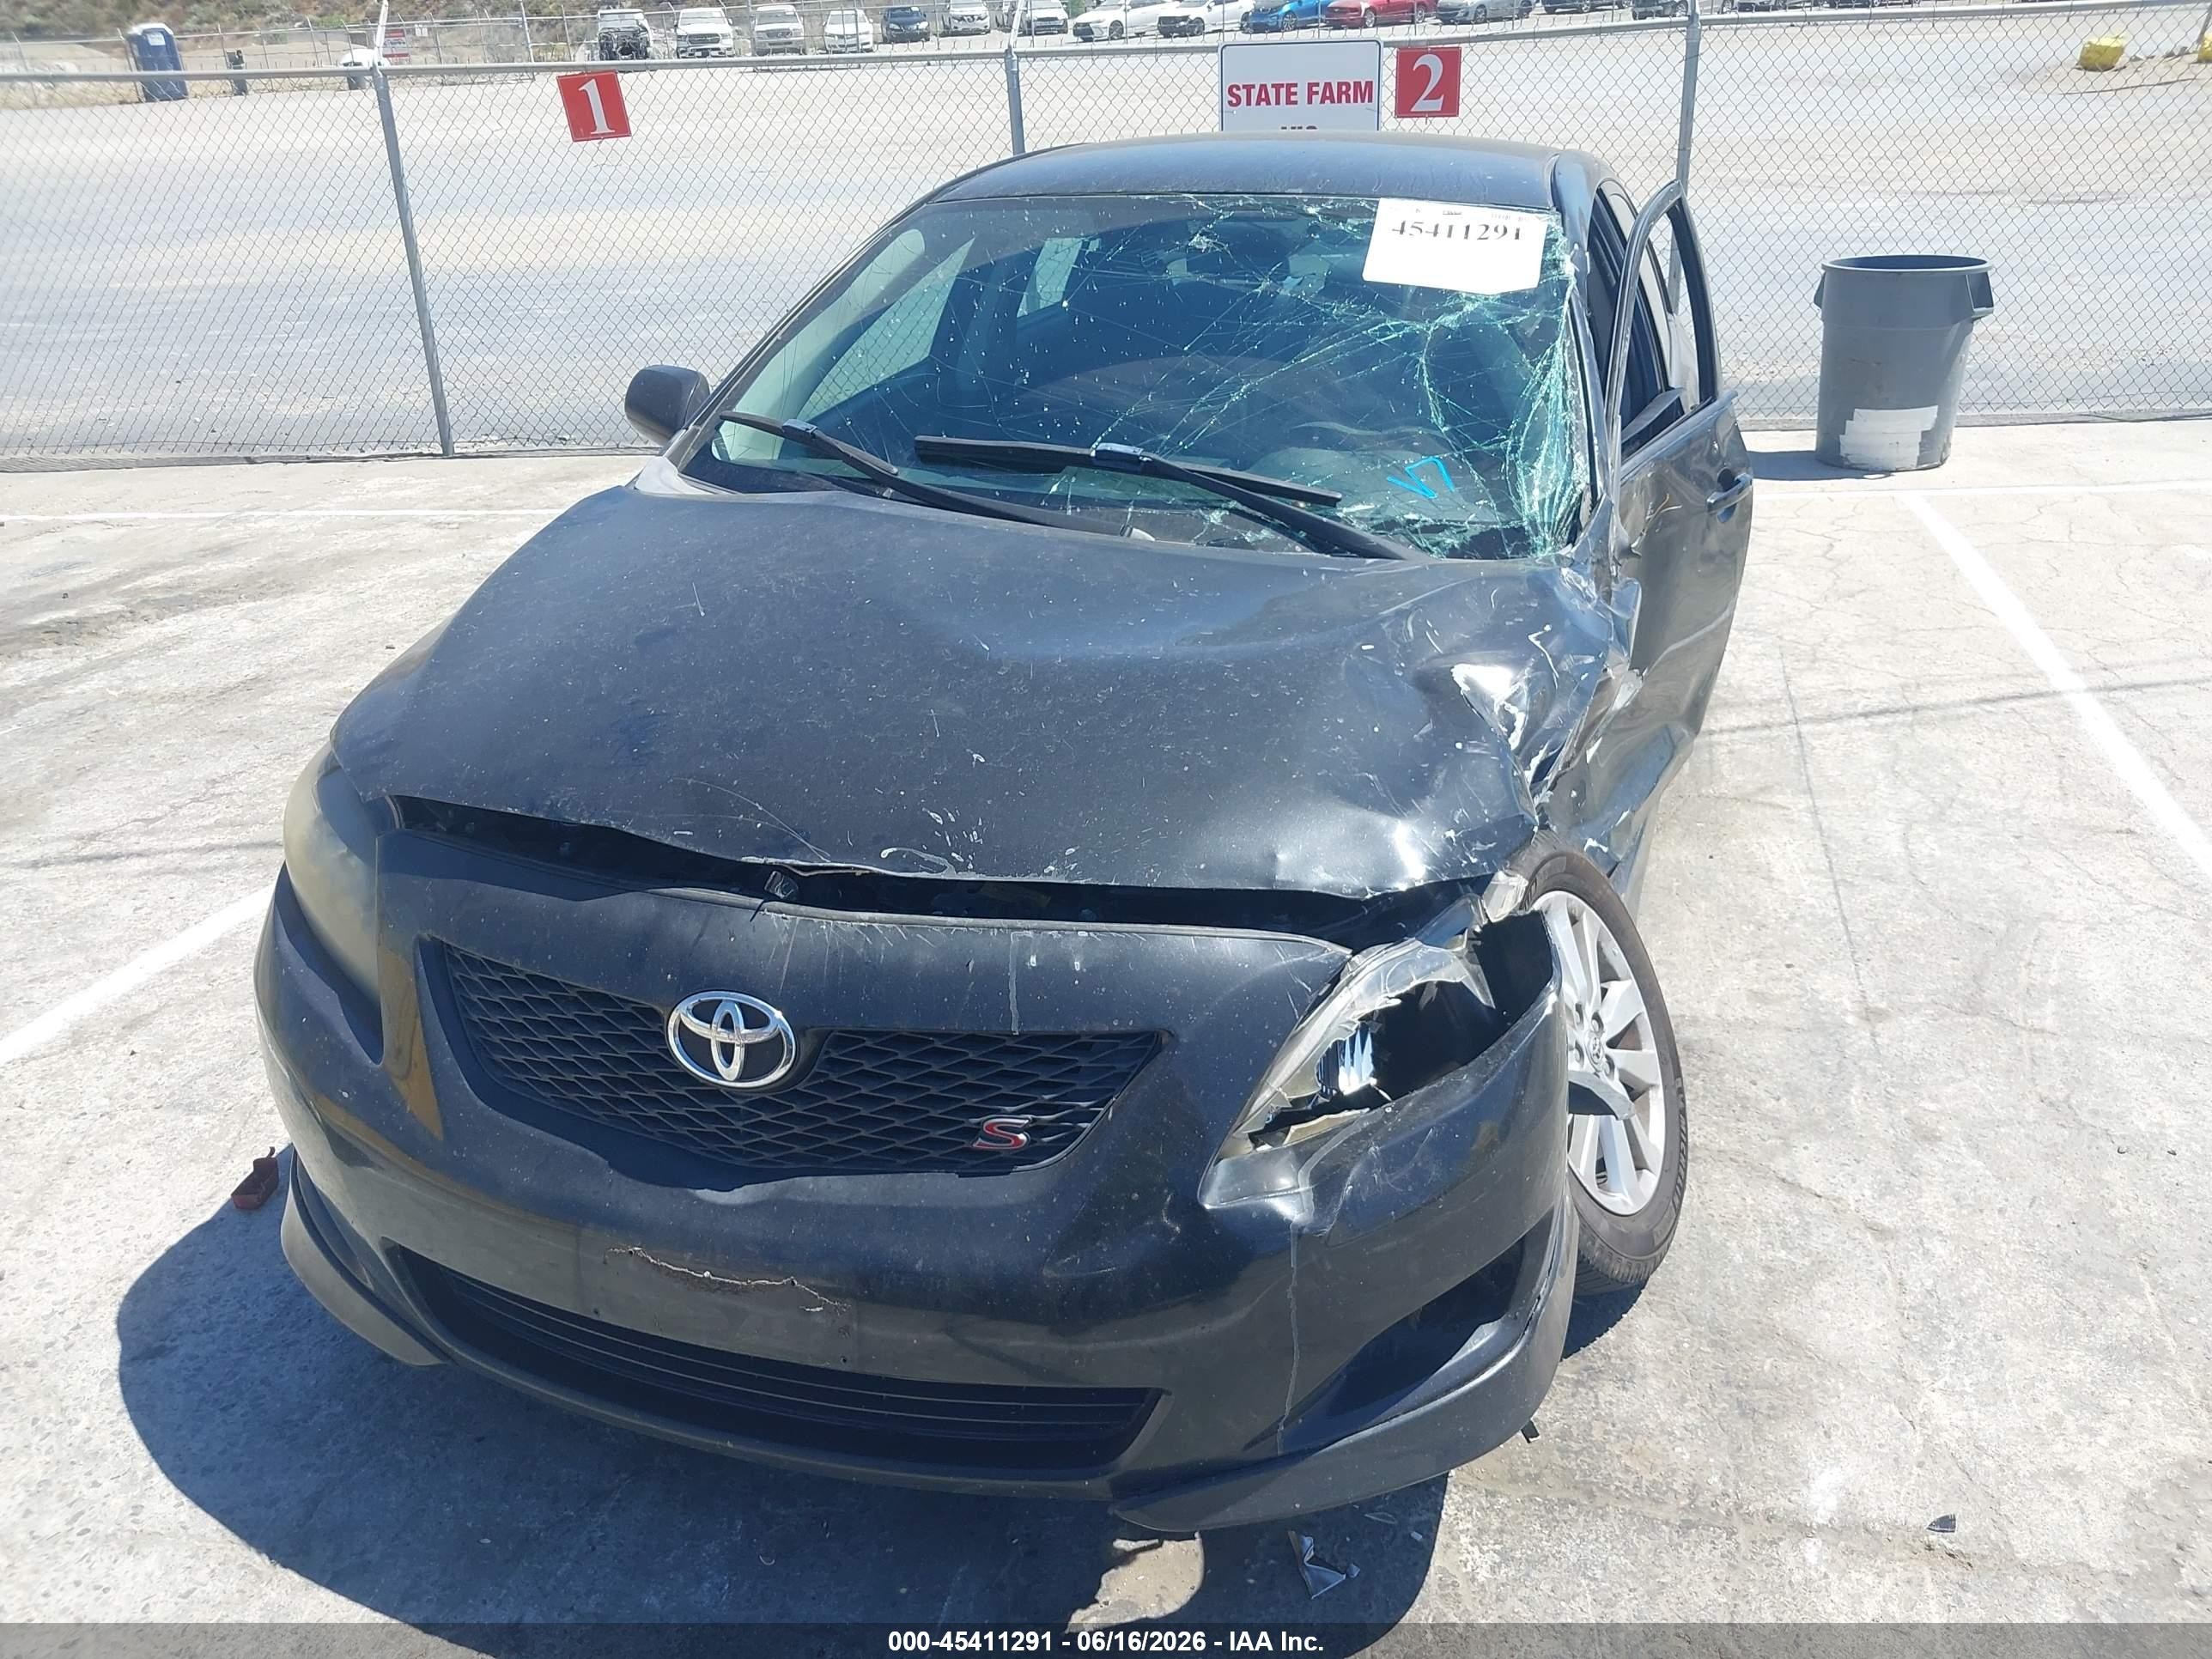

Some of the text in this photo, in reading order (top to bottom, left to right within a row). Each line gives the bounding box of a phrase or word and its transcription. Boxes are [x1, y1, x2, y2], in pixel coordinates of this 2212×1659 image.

[1227, 80, 1374, 107] STATE FARM
[1410, 53, 1445, 112] 2
[578, 79, 616, 135] 1
[1391, 220, 1521, 240] 45411291
[973, 1117, 1030, 1150] S
